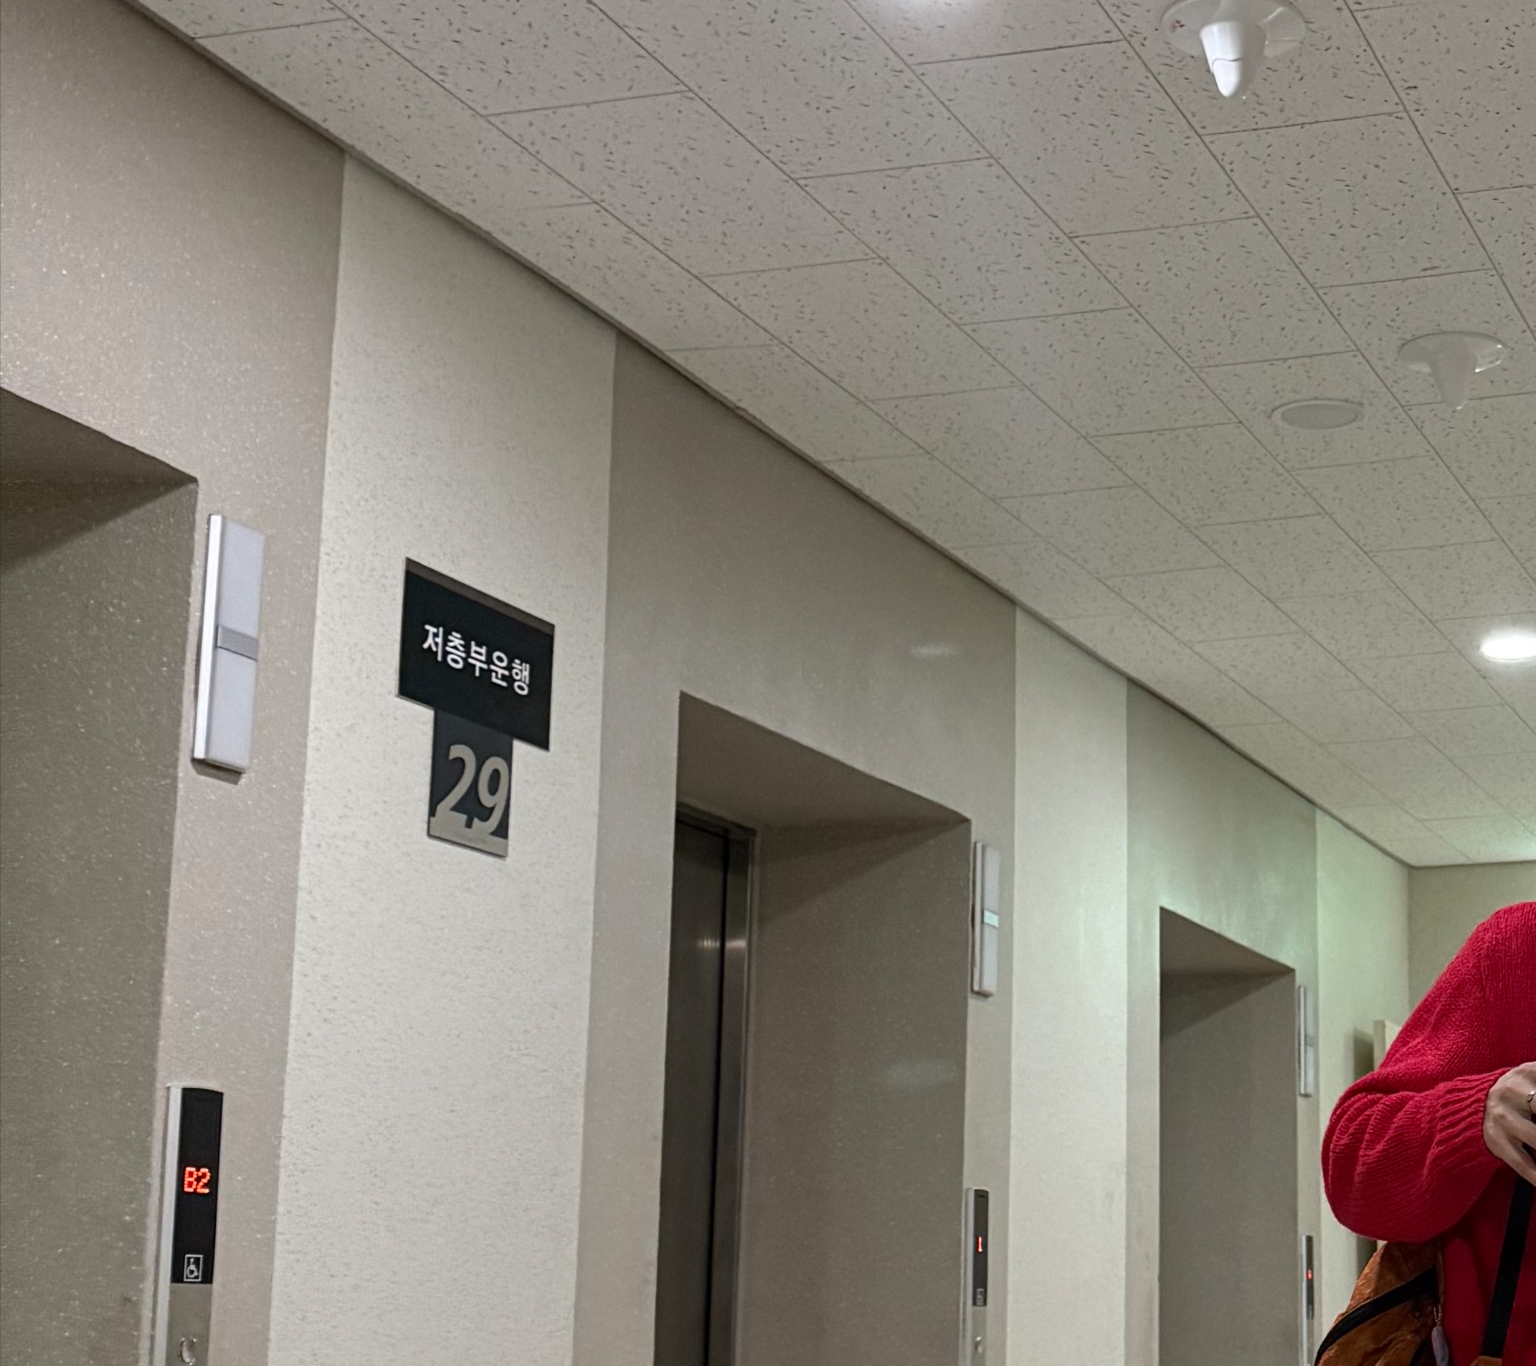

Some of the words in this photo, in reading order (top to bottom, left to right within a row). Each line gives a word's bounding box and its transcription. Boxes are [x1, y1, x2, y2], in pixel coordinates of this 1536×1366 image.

[422, 624, 530, 696] 저층부운행
[434, 744, 509, 837] 29
[183, 1166, 211, 1193] B2
